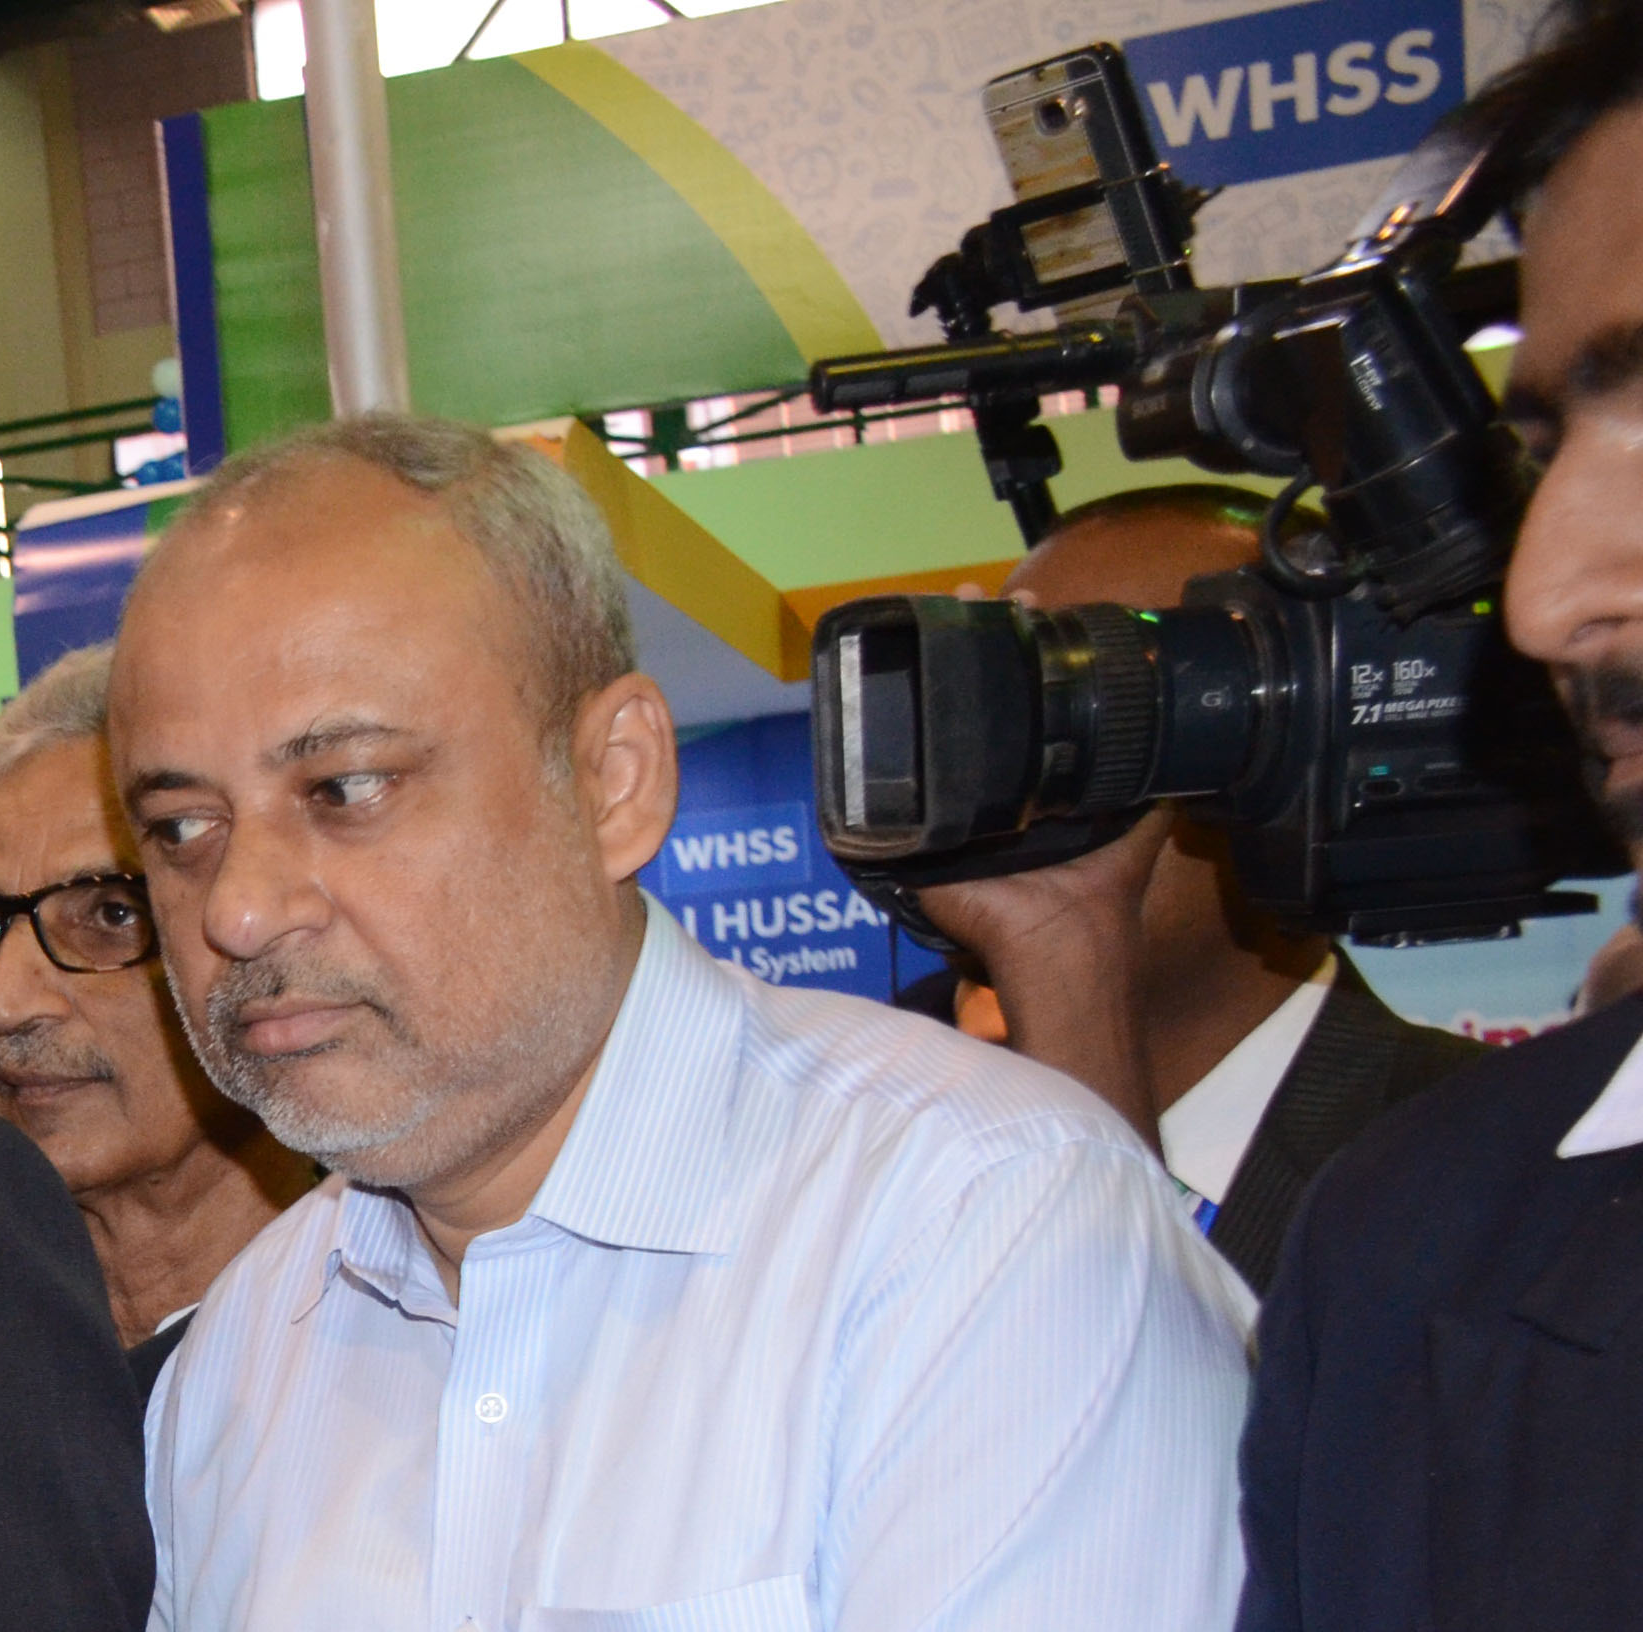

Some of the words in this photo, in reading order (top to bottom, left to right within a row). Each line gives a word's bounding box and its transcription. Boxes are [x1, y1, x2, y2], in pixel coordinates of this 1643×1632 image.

[1147, 29, 1441, 147] WHSS
[1351, 704, 1382, 725] 7.1
[672, 826, 798, 873] WHSS
[713, 890, 889, 942] HUSSA
[750, 946, 857, 985] System
